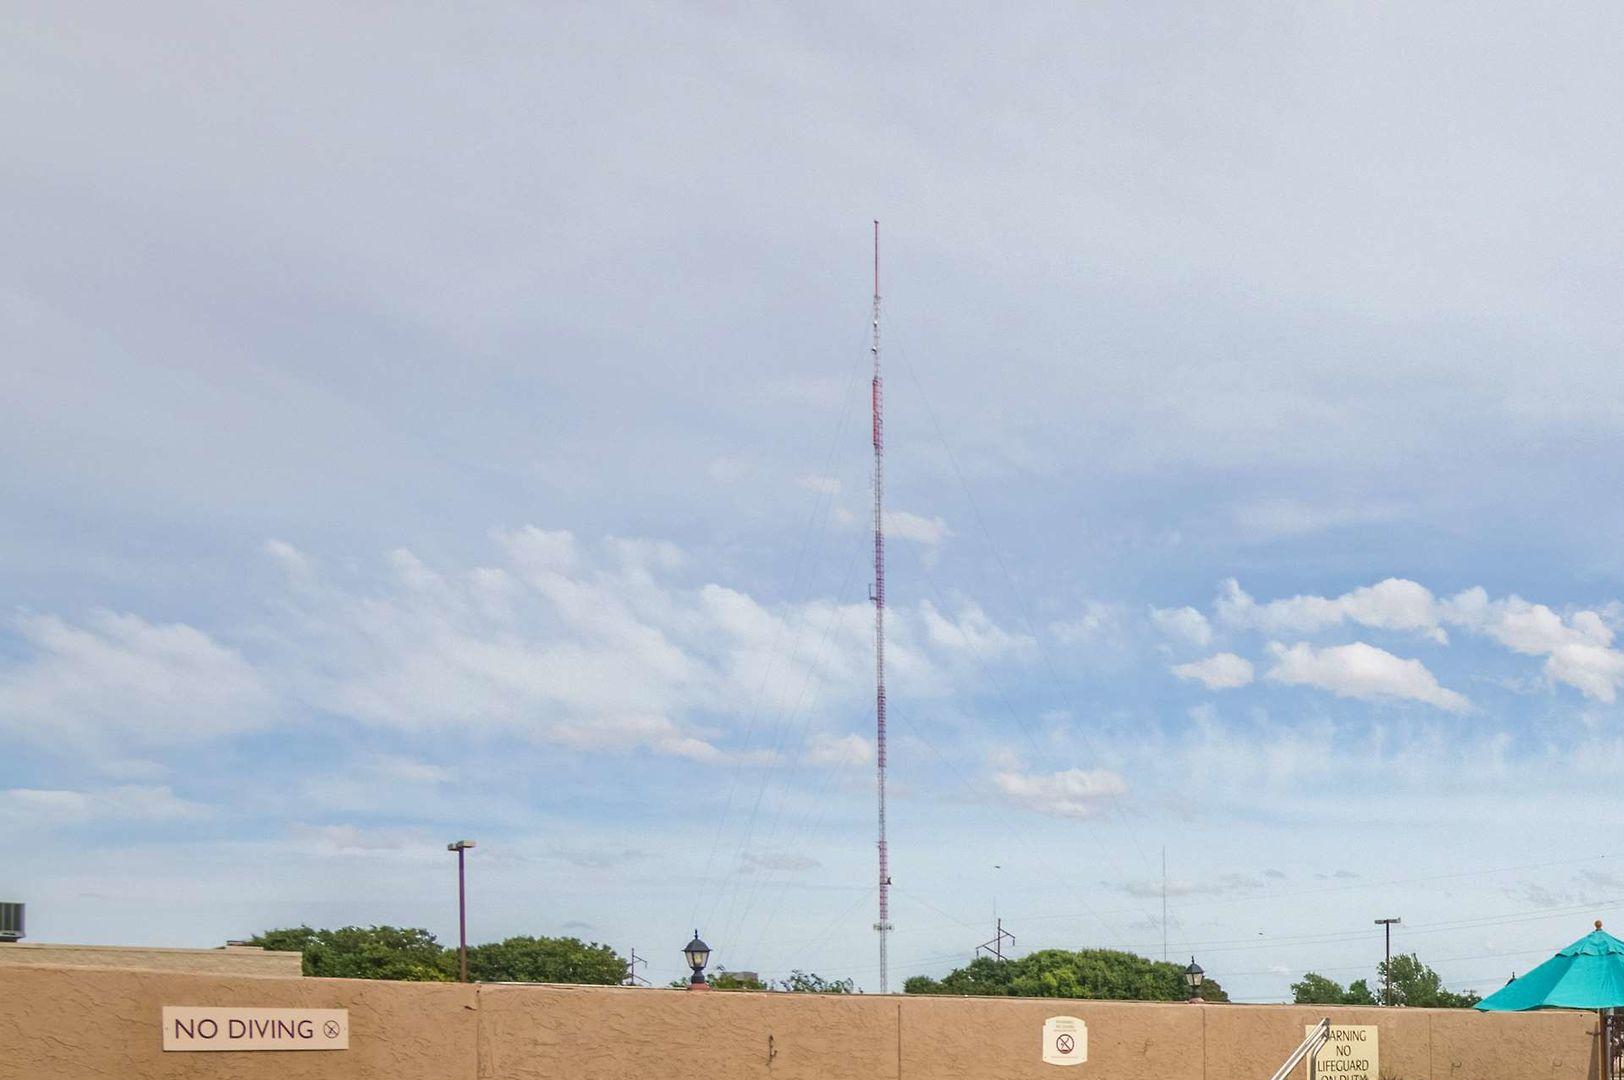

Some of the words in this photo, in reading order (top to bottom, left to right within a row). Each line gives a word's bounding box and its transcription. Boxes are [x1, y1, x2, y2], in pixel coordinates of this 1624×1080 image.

[175, 1018, 218, 1039] NO
[228, 1019, 314, 1039] DIVING
[1328, 1030, 1367, 1041] ARNING
[1336, 1045, 1352, 1056] NO
[1317, 1060, 1370, 1071] LIFEGUARD
